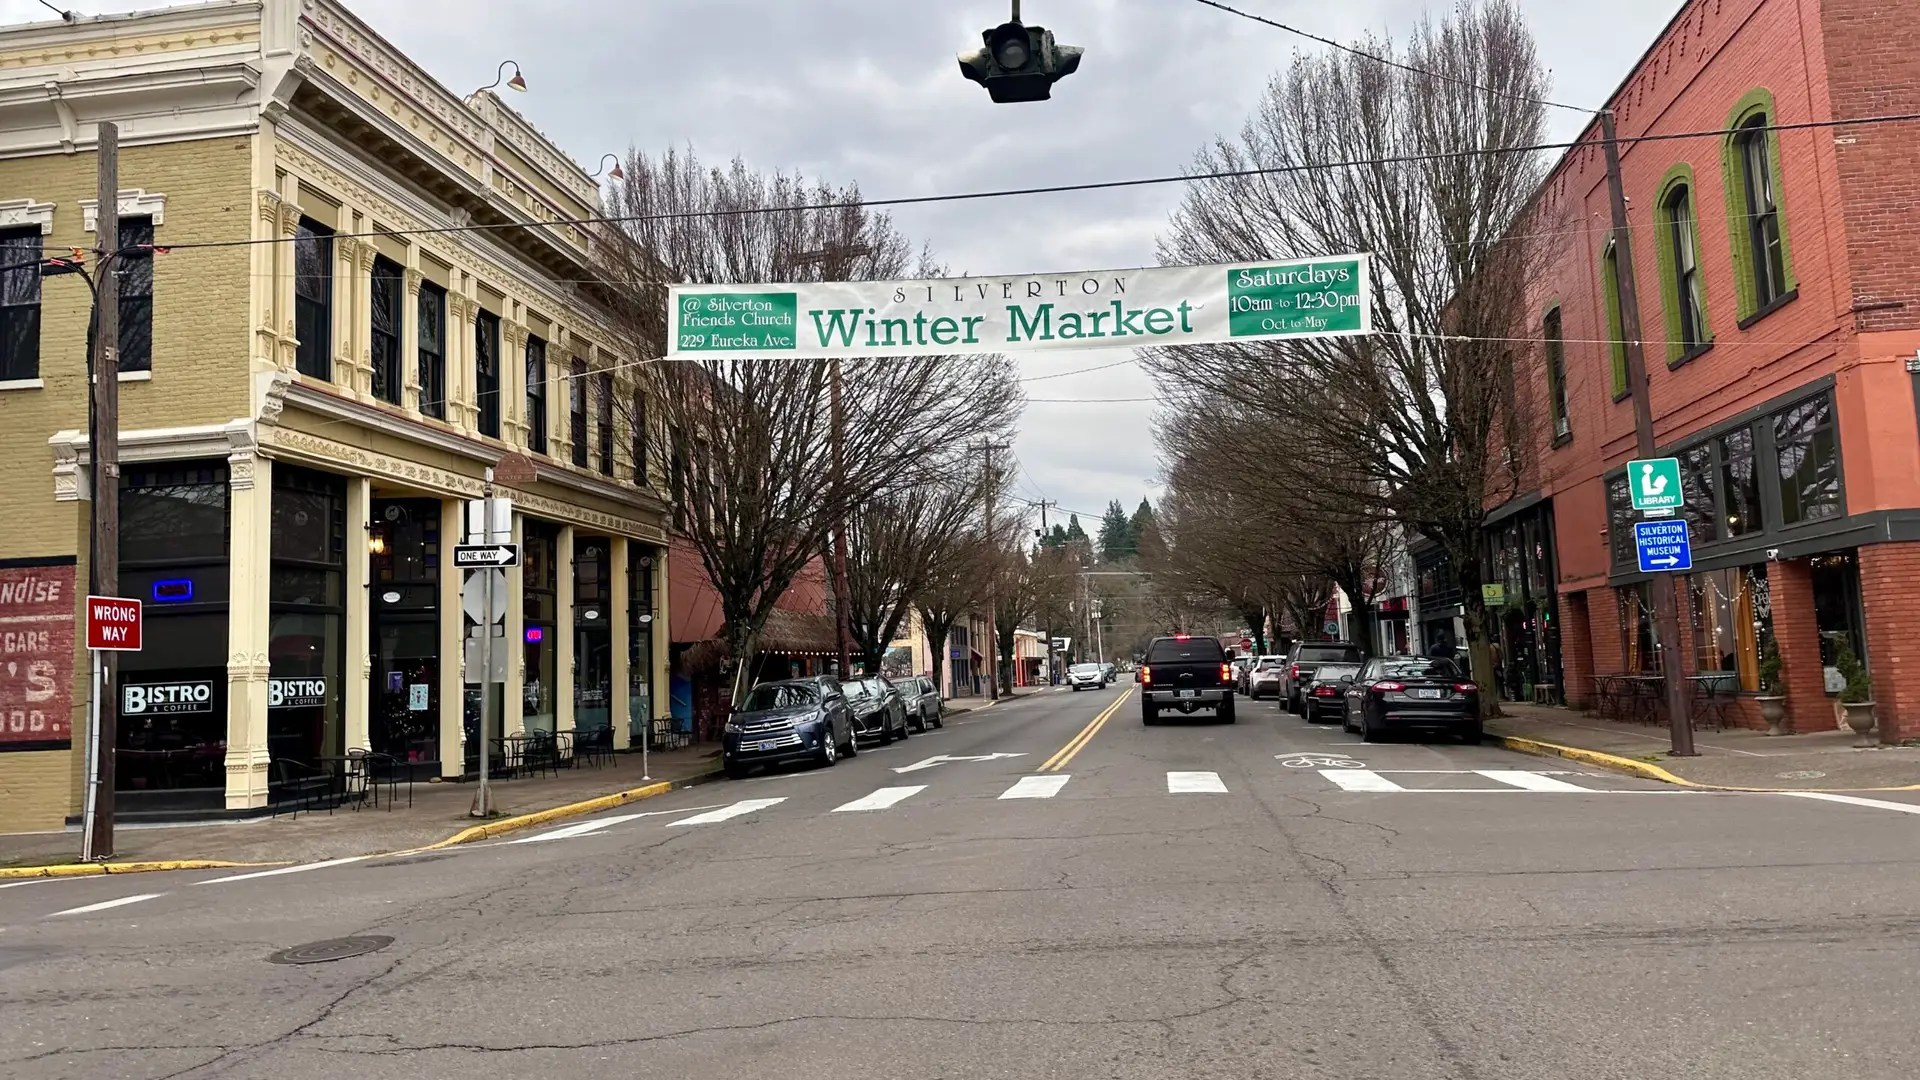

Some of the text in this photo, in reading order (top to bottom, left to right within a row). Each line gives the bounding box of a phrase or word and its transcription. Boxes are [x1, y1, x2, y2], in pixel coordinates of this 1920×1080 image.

[501, 177, 514, 198] 18
[525, 193, 558, 227] WOLF
[1236, 264, 1350, 289] Saturdays
[893, 278, 1126, 303] SILVERTON
[682, 297, 772, 314] @ Silverton
[1231, 295, 1273, 312] 10am
[1295, 290, 1360, 312] 12:30pm
[682, 312, 792, 327] Friends Church
[808, 299, 1193, 348] Winter Market
[1261, 318, 1287, 330] Oct
[1305, 315, 1328, 331] May
[680, 332, 794, 348] 229 Eureka Ave.
[1638, 496, 1675, 505] LIBRARY
[1640, 525, 1682, 535] SILVERTON
[1639, 535, 1686, 547] HISTORICAL
[460, 551, 498, 561] ONE WAY
[1647, 546, 1681, 556] MUSEUM
[94, 605, 136, 622] WRONG
[0, 630, 49, 654] GARS
[102, 626, 128, 641] WAY
[0, 660, 57, 702] 'S
[124, 684, 210, 713] BISTRO
[269, 679, 326, 706] BISTRO
[163, 703, 198, 712] COFFEE
